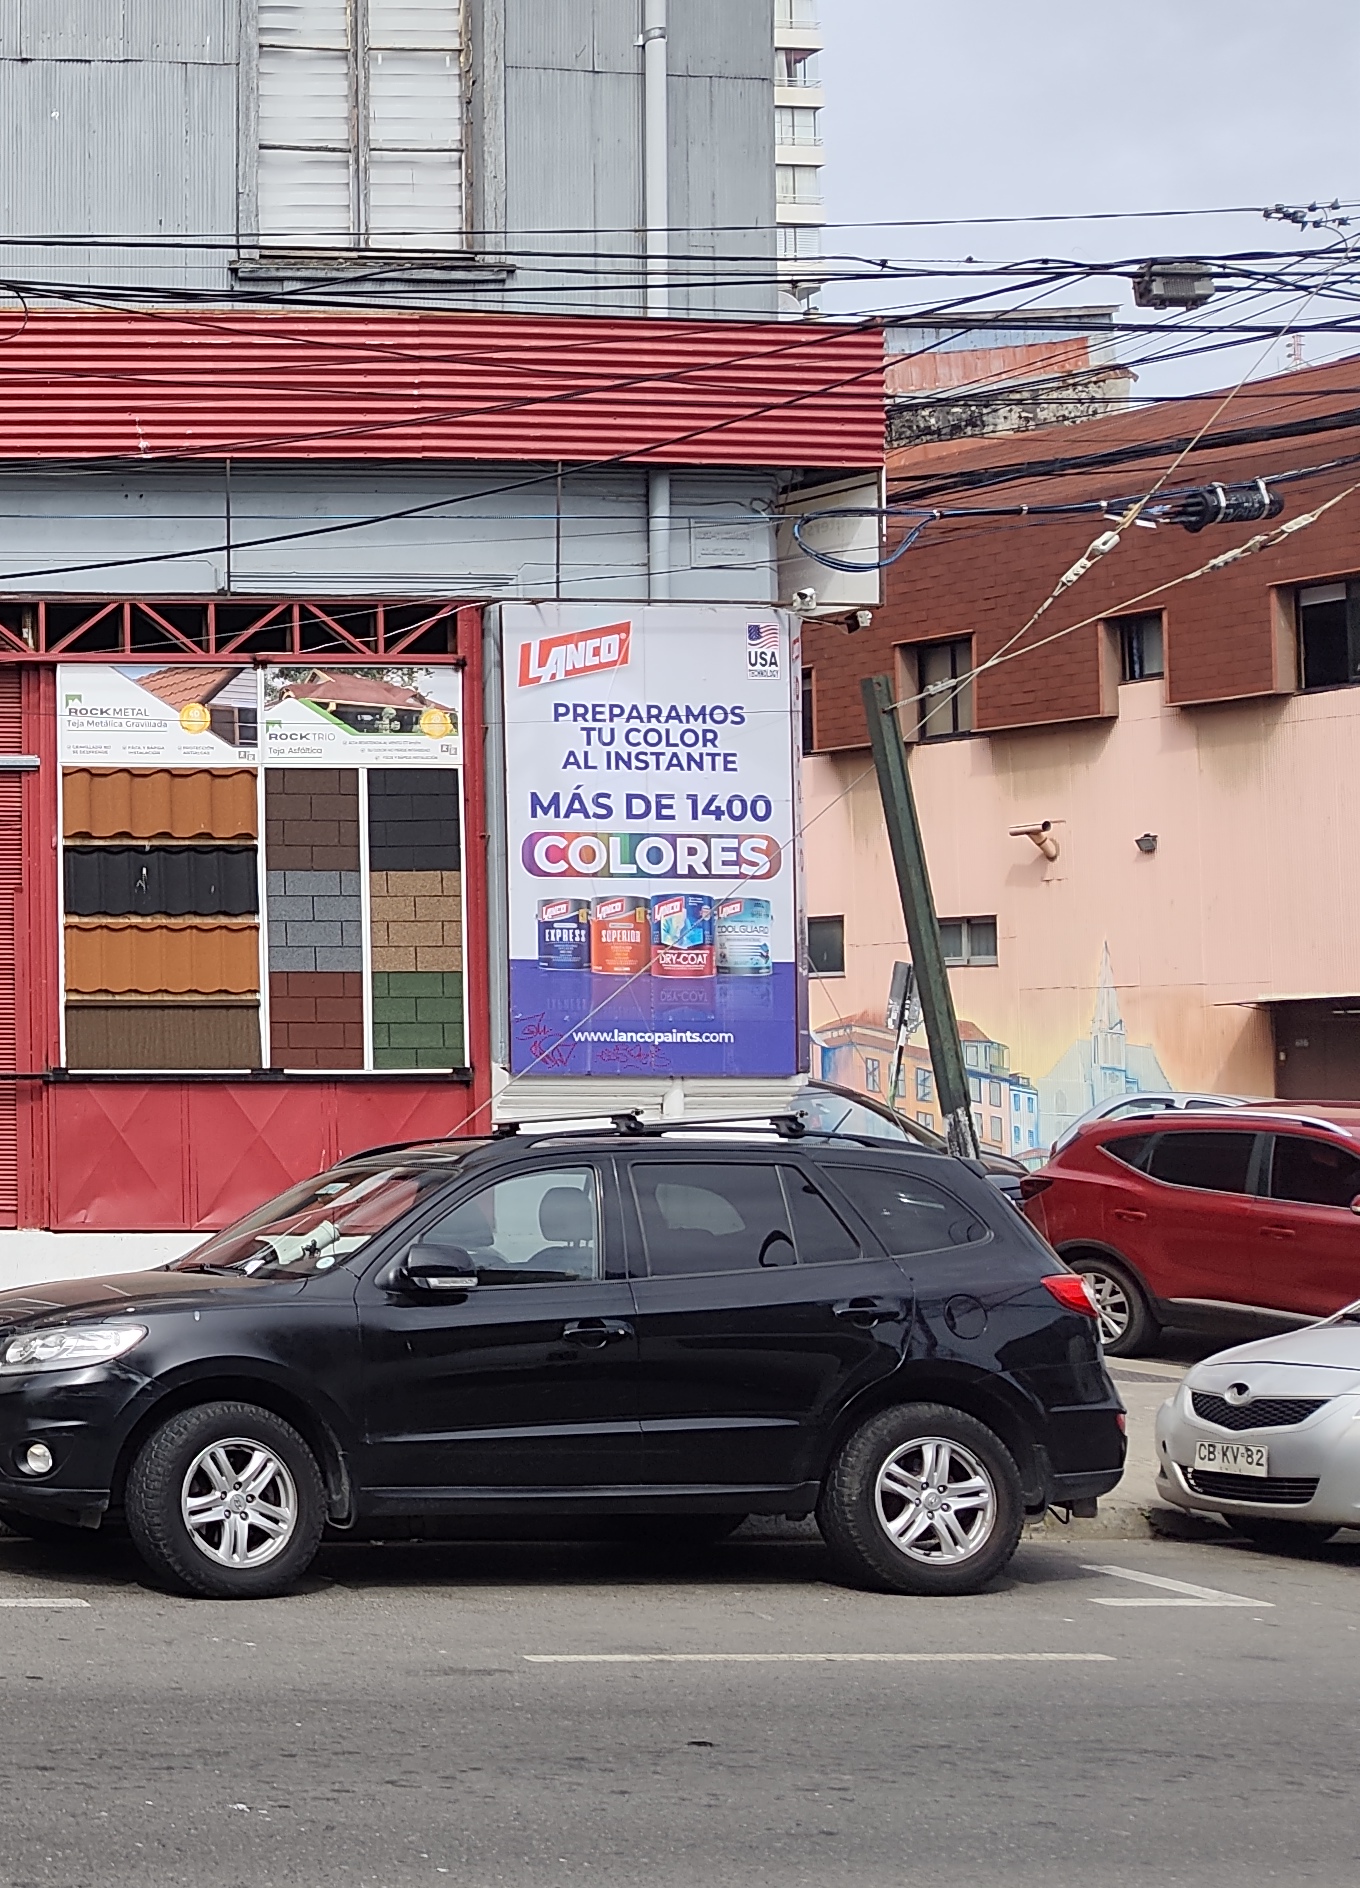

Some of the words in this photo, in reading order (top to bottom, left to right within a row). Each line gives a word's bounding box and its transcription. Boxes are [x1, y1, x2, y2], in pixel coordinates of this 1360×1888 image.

[529, 632, 621, 684] LANCO
[748, 650, 779, 668] USA
[552, 702, 746, 726] PREPARAMOS
[67, 720, 85, 729] Teja
[87, 719, 123, 729] Metálica
[125, 720, 168, 729] Gravillada
[580, 727, 615, 747] TU
[624, 727, 719, 749] COLOR
[268, 747, 285, 756] Teja
[288, 746, 323, 755] Asfáltica
[562, 750, 598, 770] AL
[606, 751, 739, 773] INSTANTE
[530, 785, 614, 820] MÁS
[625, 793, 677, 821] DE
[686, 793, 773, 822] 1400
[533, 836, 771, 876] COLORES
[545, 929, 588, 942] EXPRESS
[601, 929, 641, 943] SUPERIOR
[659, 952, 708, 965] DRY-COAT
[572, 1029, 735, 1045] www.lancopaints.com
